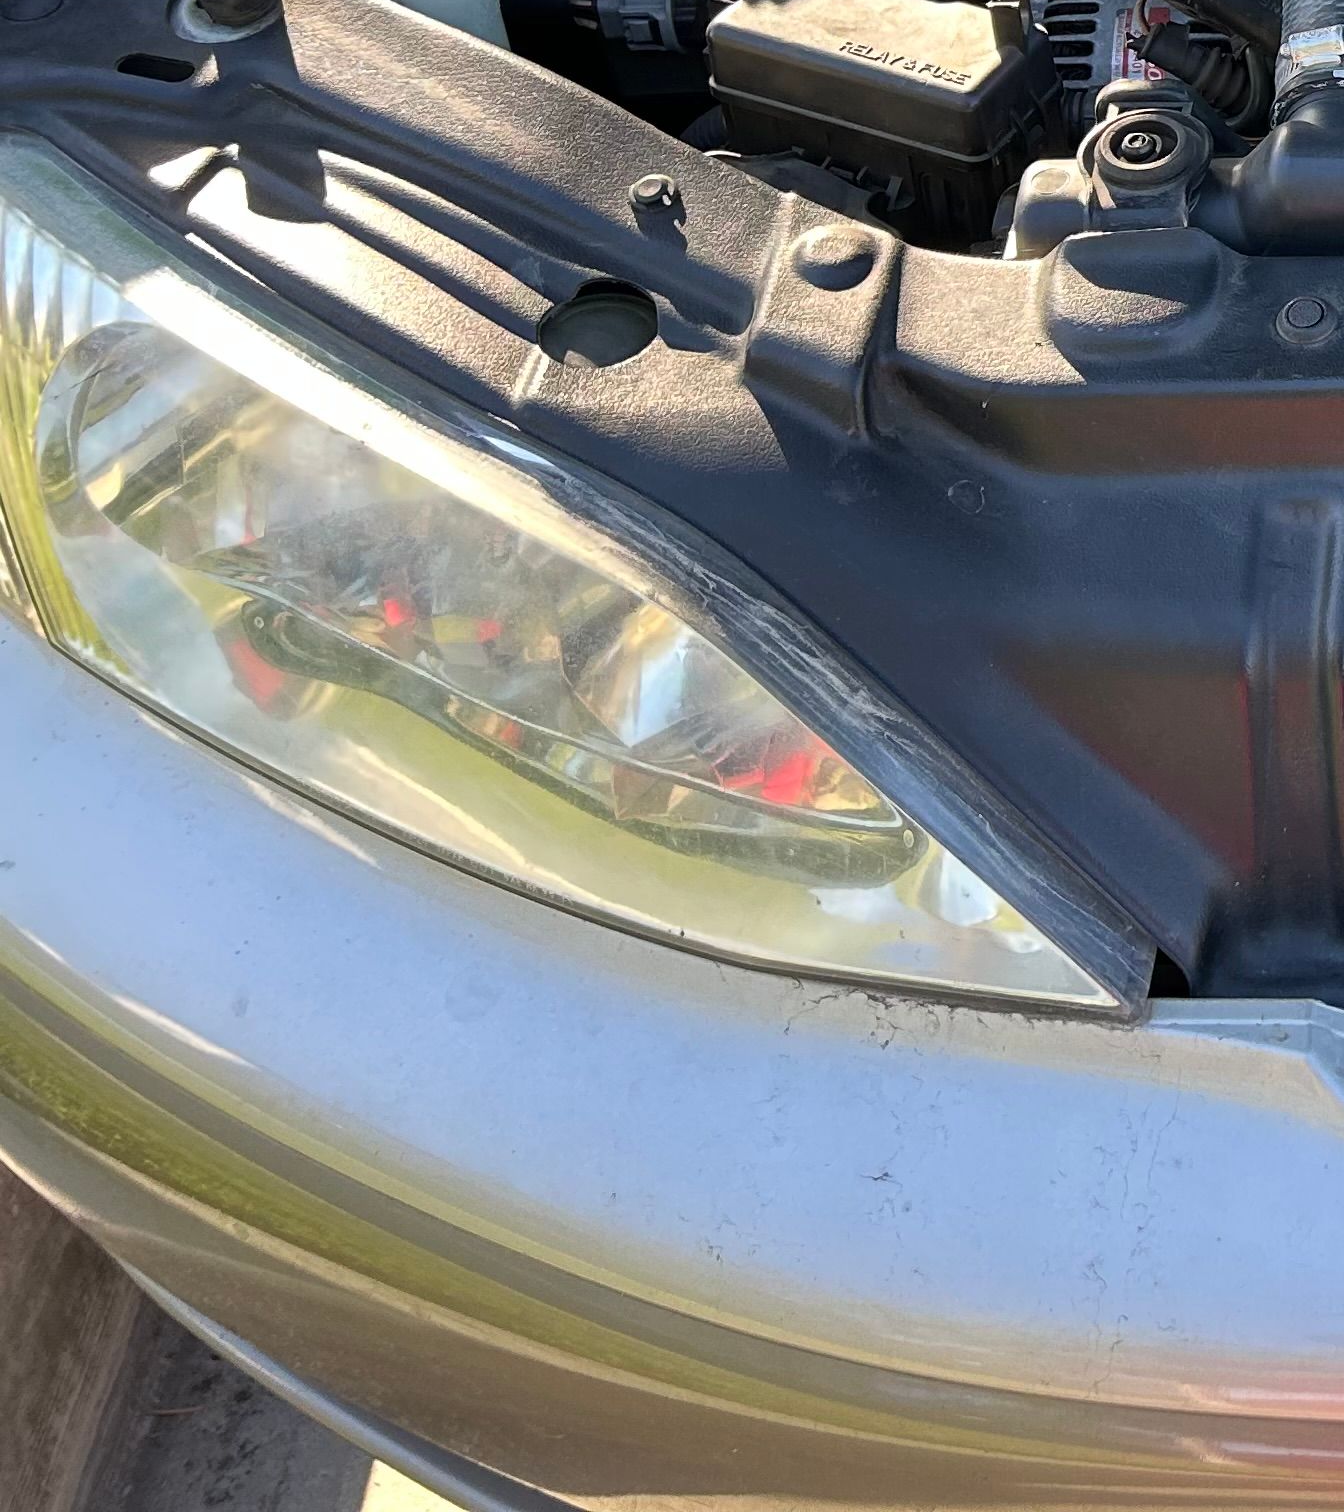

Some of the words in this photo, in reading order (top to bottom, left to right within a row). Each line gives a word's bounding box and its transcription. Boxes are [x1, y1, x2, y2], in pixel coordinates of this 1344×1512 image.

[839, 41, 905, 66] RELAY
[903, 60, 917, 72] &
[918, 64, 971, 85] FUSE
